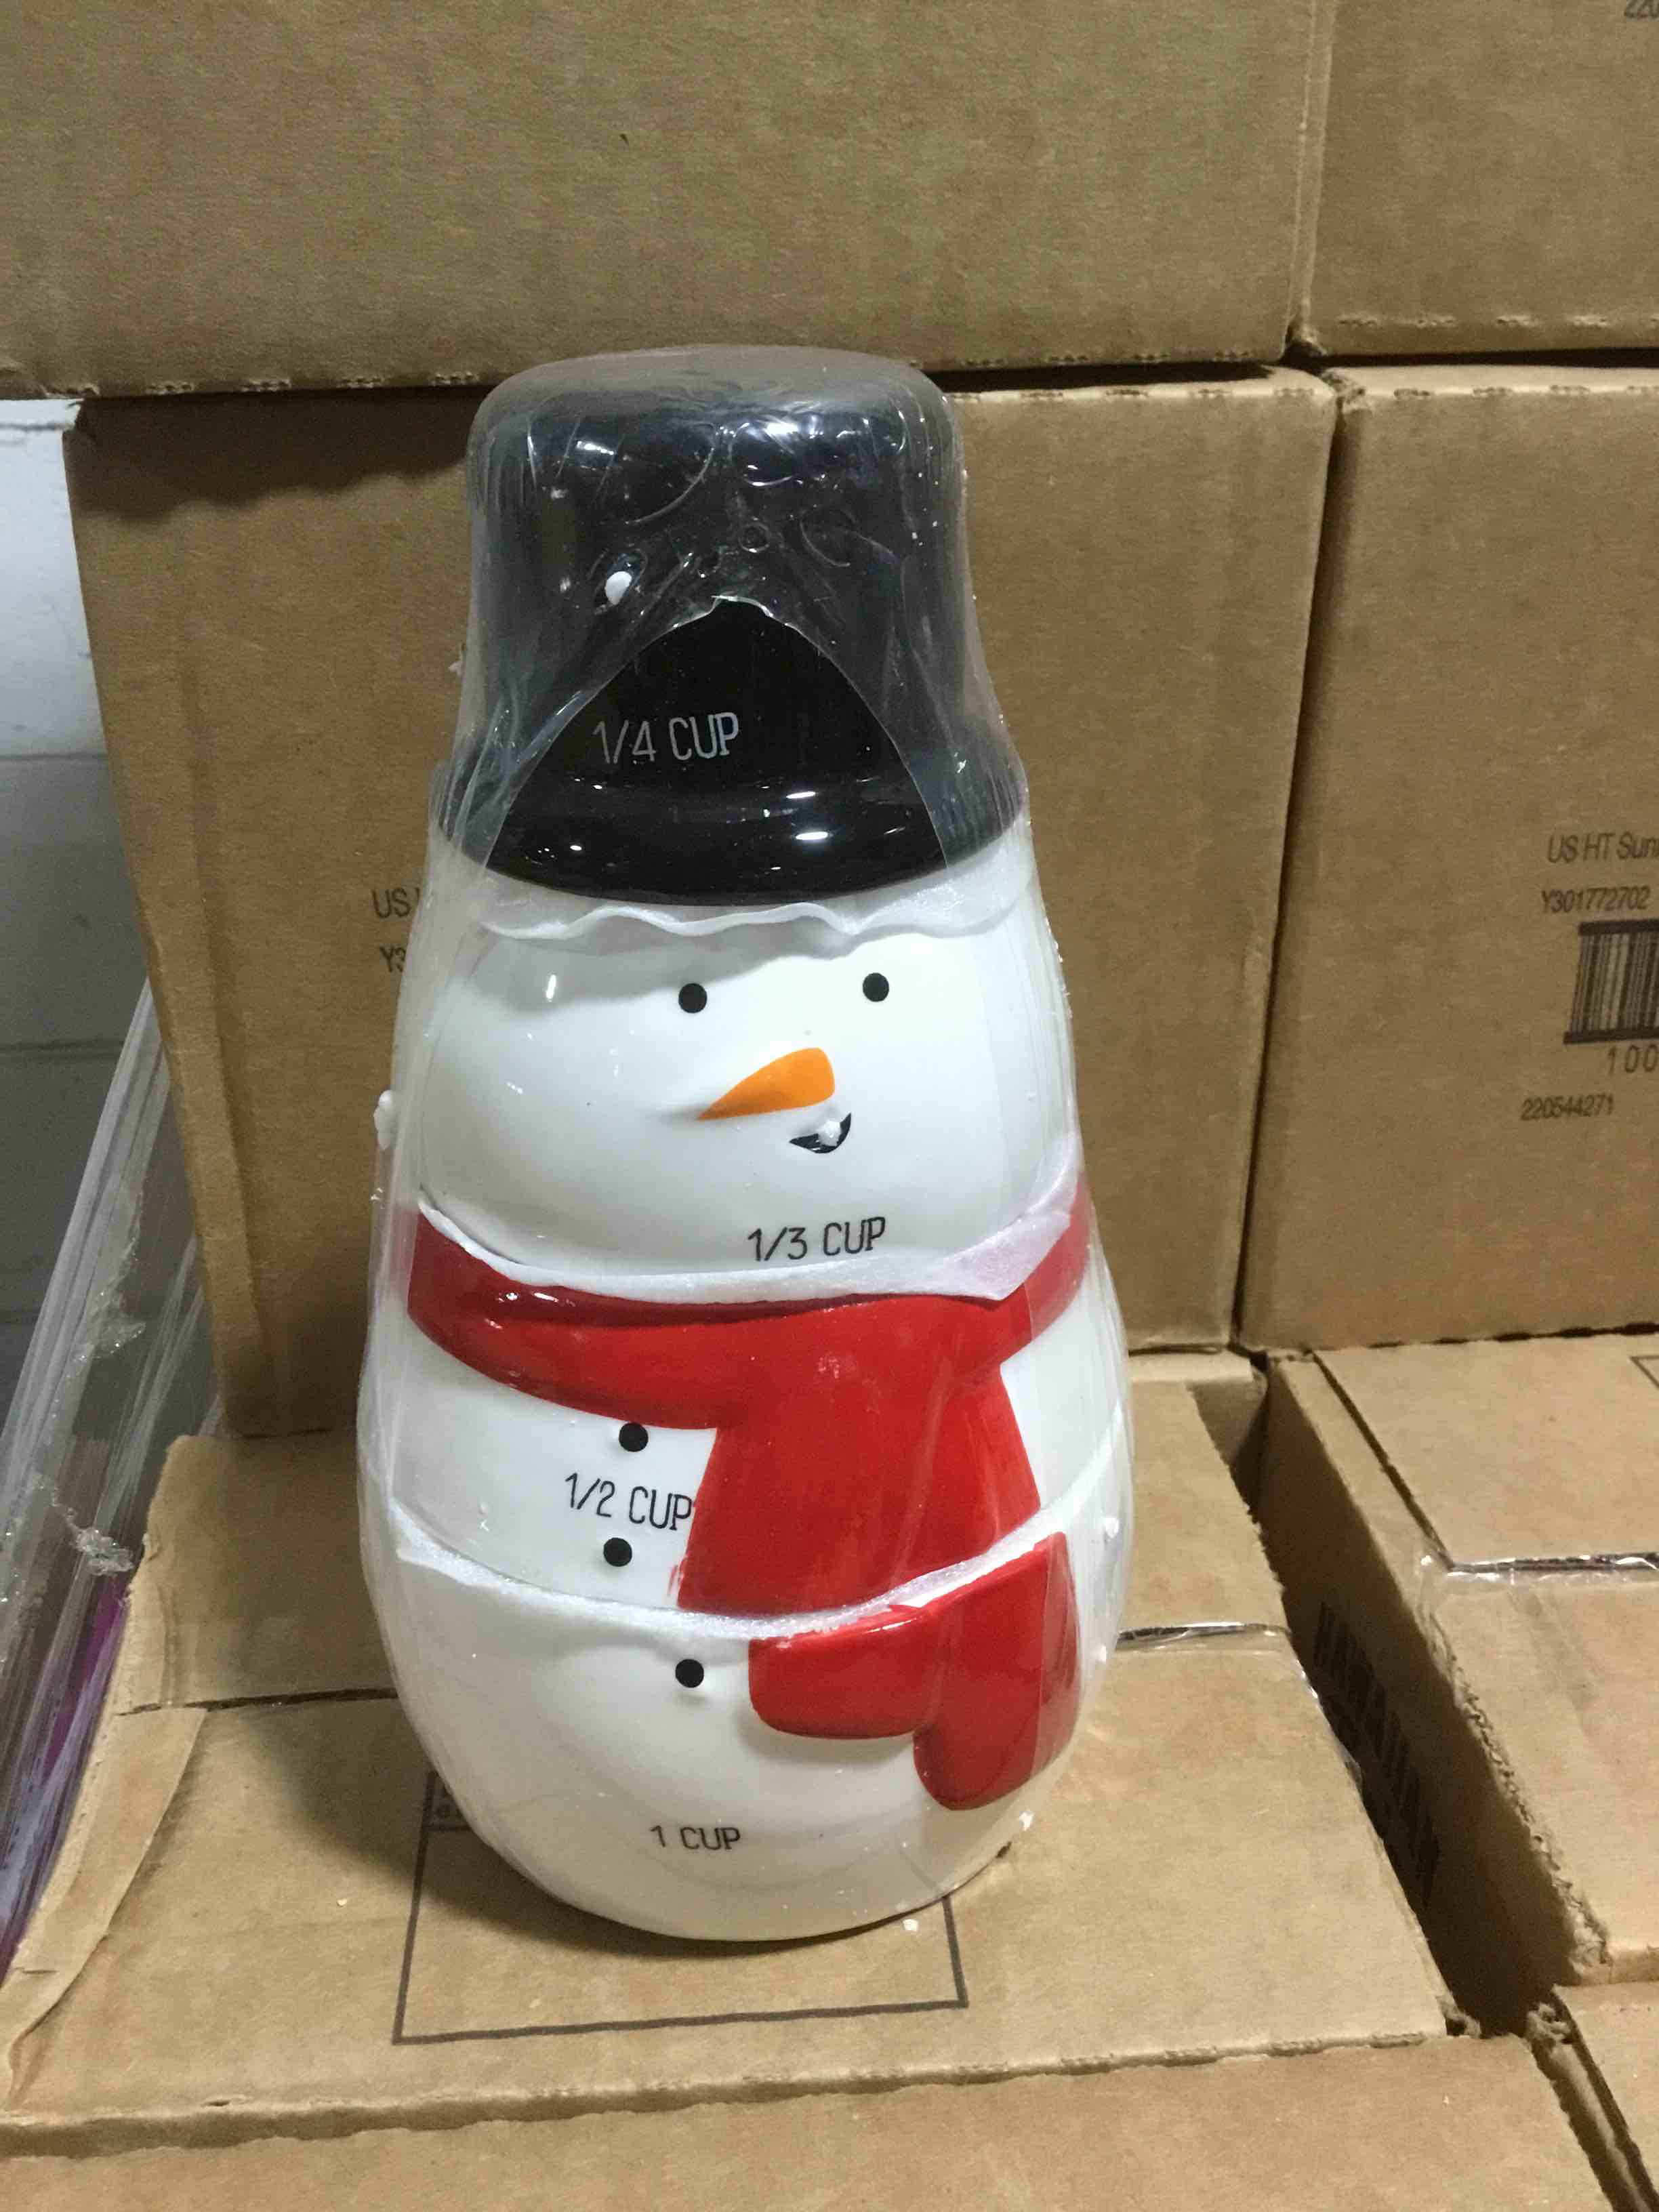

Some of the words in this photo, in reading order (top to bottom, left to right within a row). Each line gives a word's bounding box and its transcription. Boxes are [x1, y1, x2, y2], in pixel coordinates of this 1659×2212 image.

[1624, 0, 1659, 18] 220
[592, 719, 657, 764] 1/4
[669, 712, 739, 760] CUP
[1548, 834, 1578, 863] US
[1583, 833, 1616, 861] HT
[1617, 832, 1659, 860] Sun
[371, 887, 411, 918] US
[1541, 886, 1650, 914] Y301772702
[1521, 1094, 1614, 1121] 220544271
[747, 1227, 807, 1261] 1/3
[823, 1216, 886, 1256] CUP
[565, 1472, 615, 1517] 1/2
[629, 1486, 693, 1530] CUP
[650, 1825, 666, 1848] 1
[680, 1827, 741, 1851] CUP
